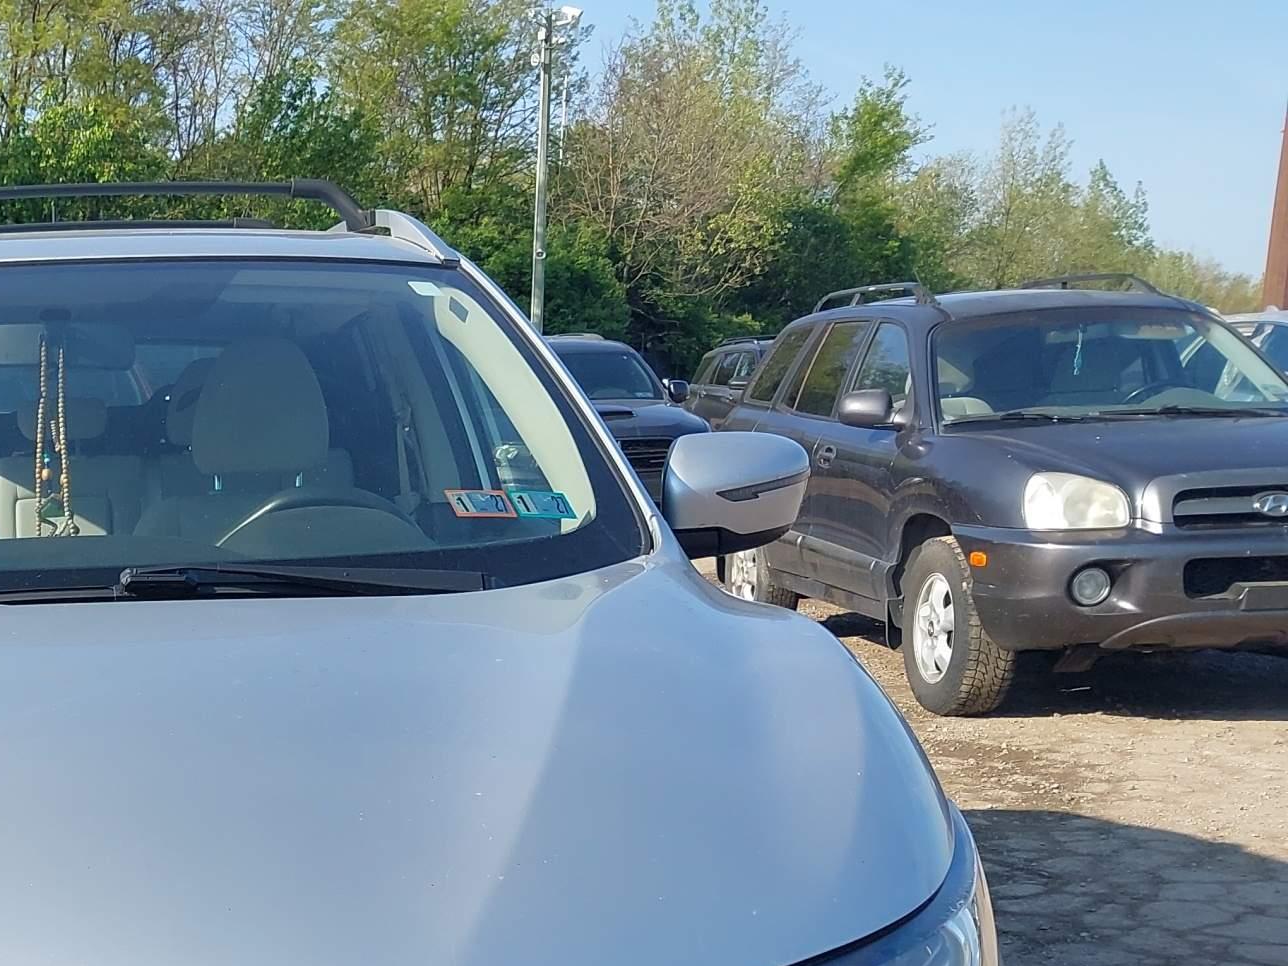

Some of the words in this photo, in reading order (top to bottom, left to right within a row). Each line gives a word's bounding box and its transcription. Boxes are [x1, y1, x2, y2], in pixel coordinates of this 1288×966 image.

[455, 496, 470, 513] 1
[489, 494, 510, 513] 27
[516, 495, 532, 513] 1
[550, 495, 570, 515] 27
